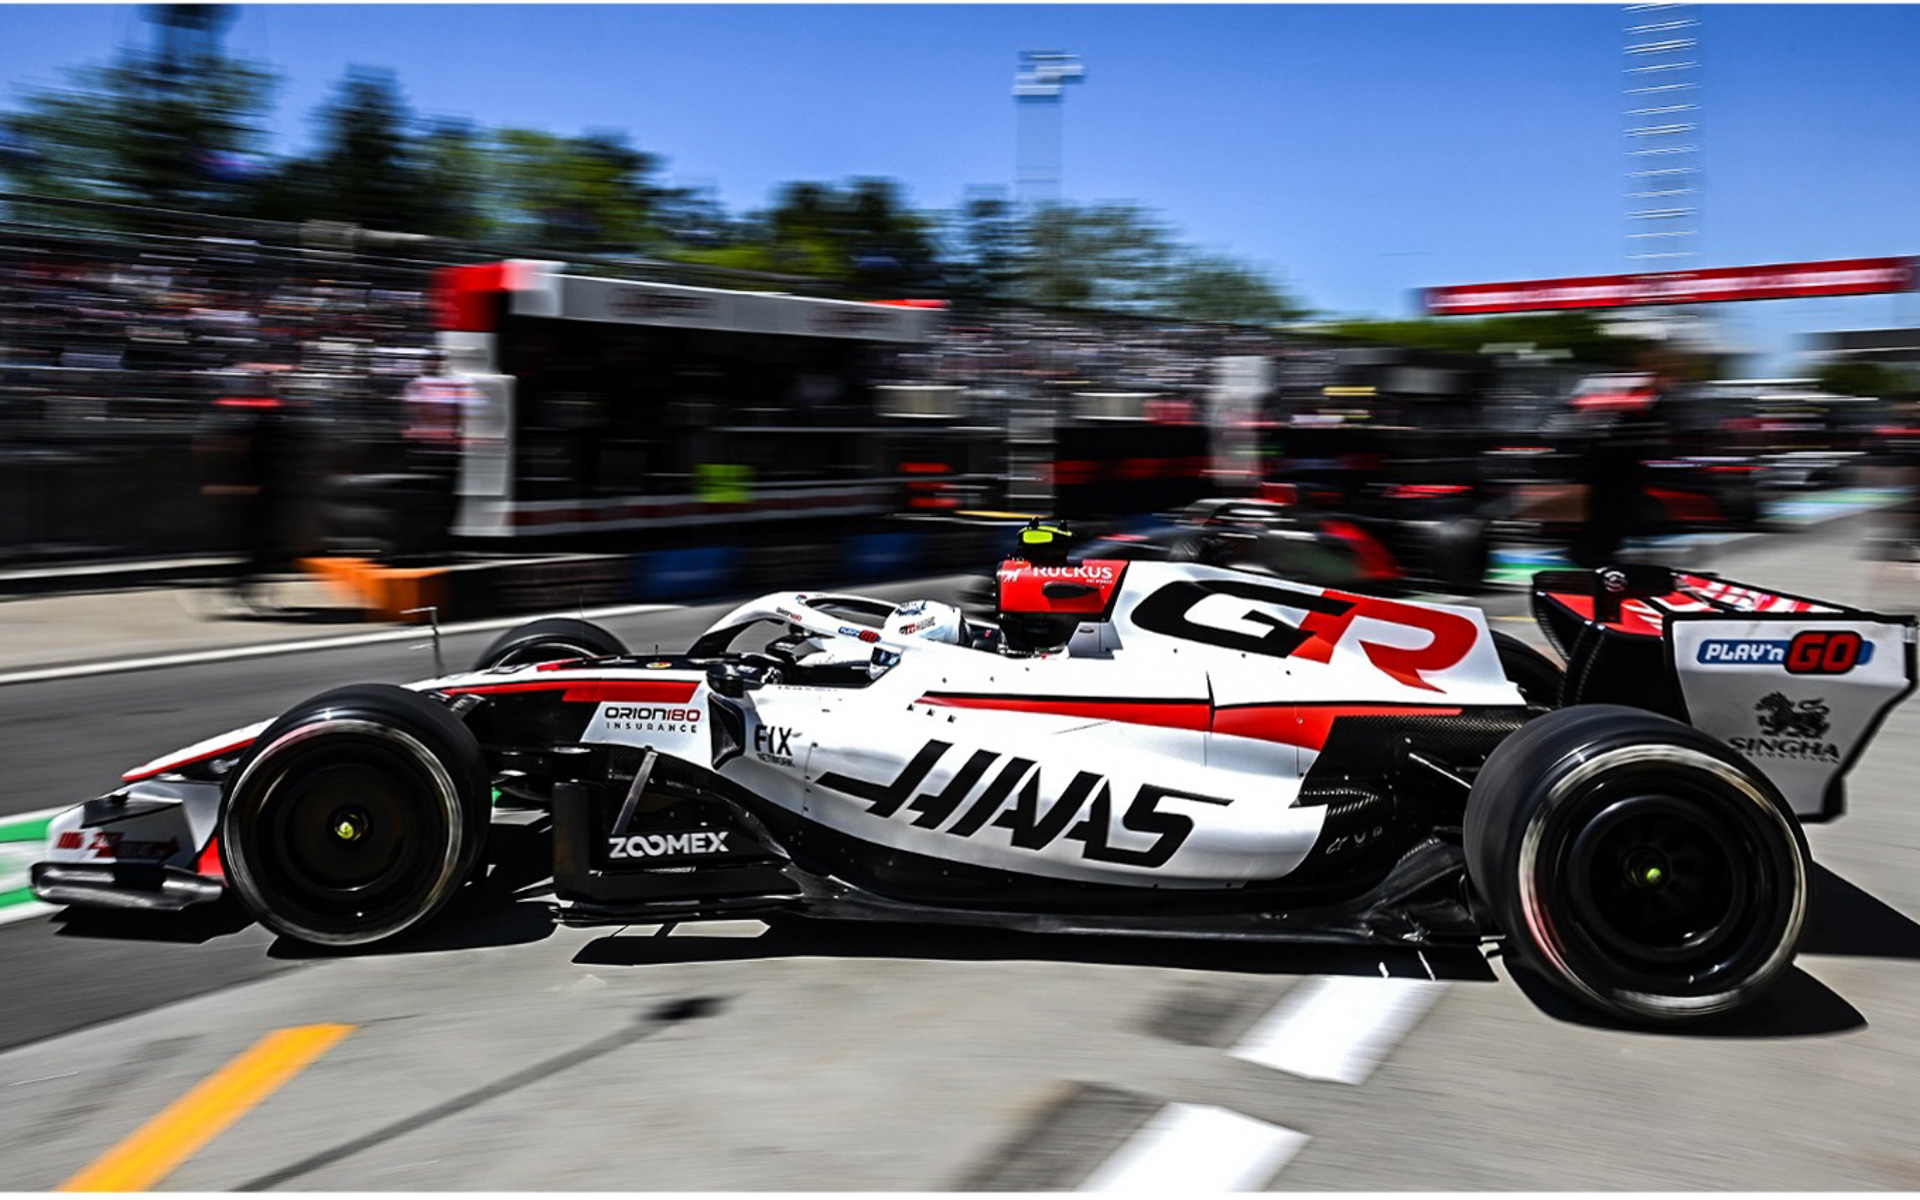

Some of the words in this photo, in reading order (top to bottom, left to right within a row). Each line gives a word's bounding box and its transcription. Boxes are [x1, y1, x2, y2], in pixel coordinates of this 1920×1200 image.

[1033, 566, 1112, 579] RUCKUS
[1131, 580, 1478, 694] GR
[1788, 632, 1859, 672] GO
[604, 706, 701, 722] ORION180
[606, 722, 698, 733] INSURANCE
[754, 724, 793, 757] FIX
[1727, 737, 1840, 759] SINGHA
[813, 739, 1235, 868] HAAS
[608, 831, 730, 859] ZOOMEX
